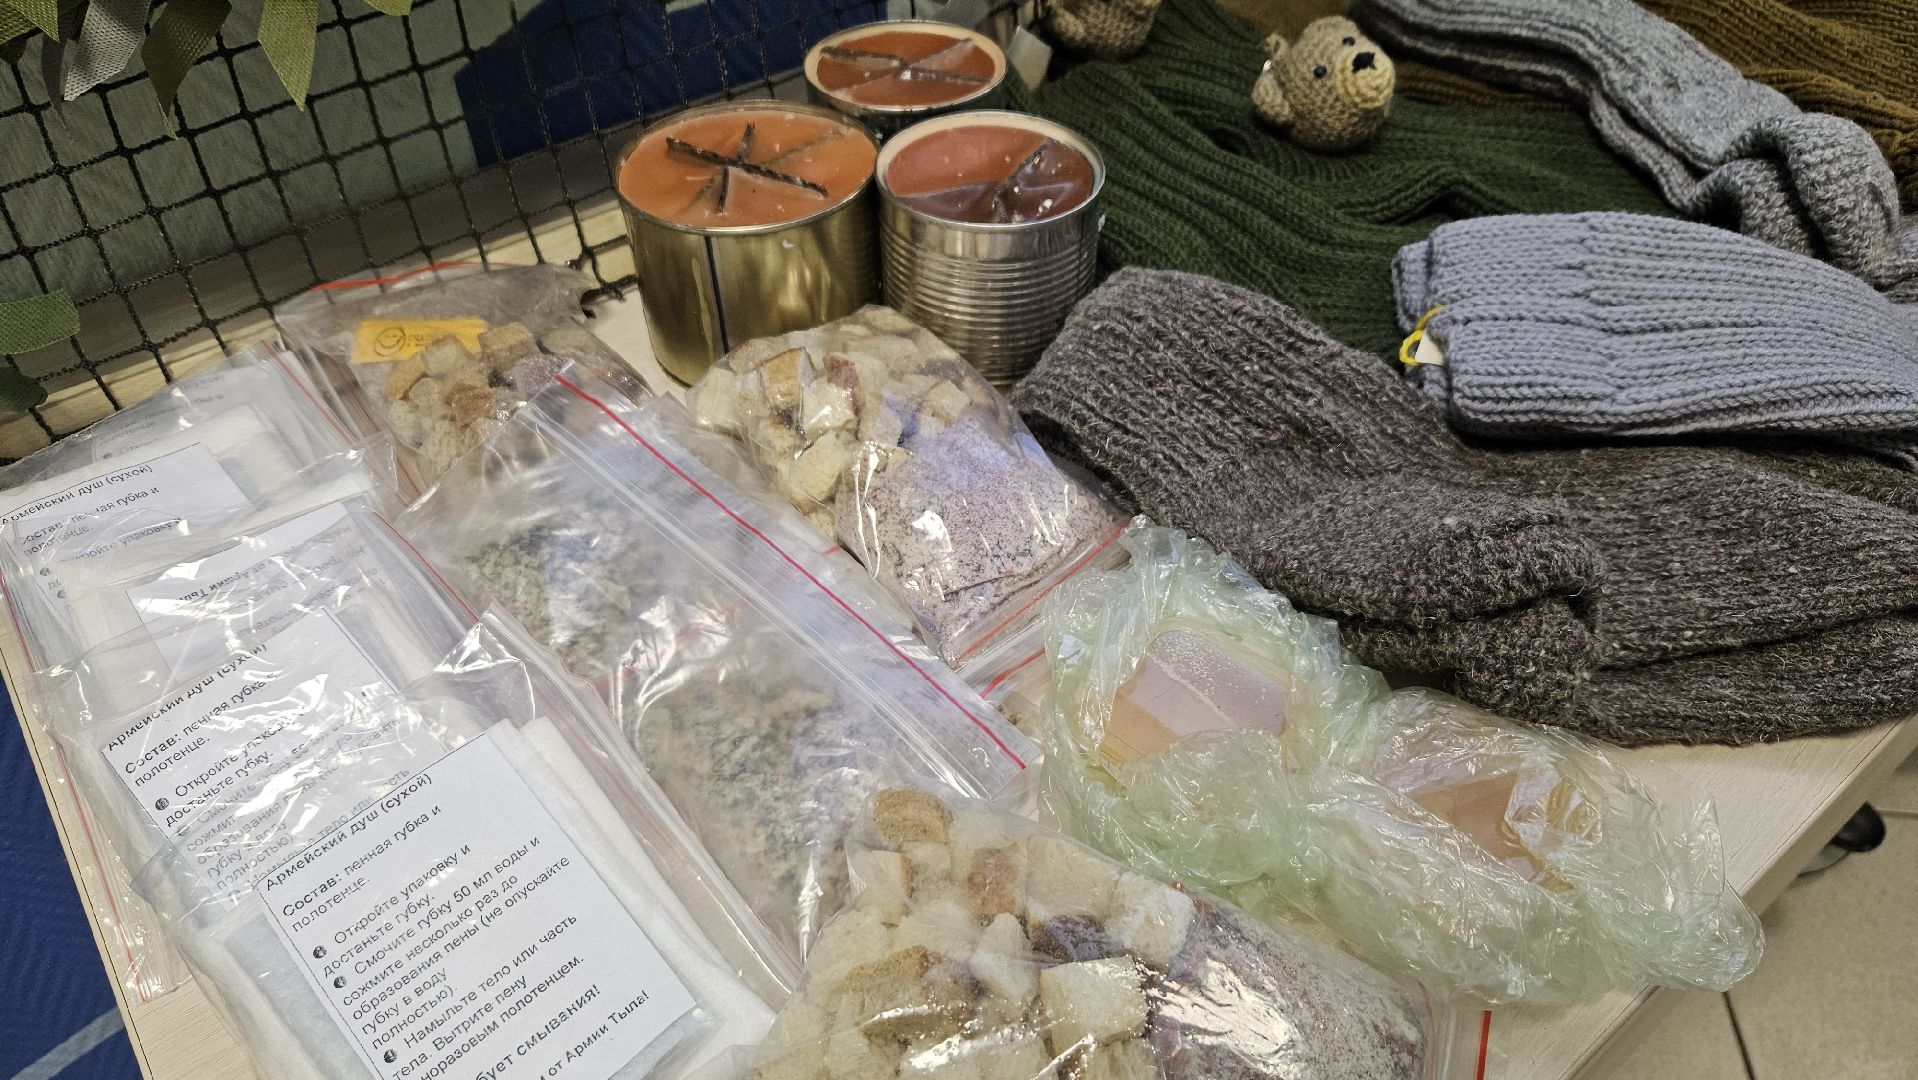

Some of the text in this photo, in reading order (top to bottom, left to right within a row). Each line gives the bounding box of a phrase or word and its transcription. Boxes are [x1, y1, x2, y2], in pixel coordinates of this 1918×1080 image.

[77, 480, 104, 496] душ
[104, 463, 153, 484] (сухой)
[115, 491, 149, 505] губка
[124, 681, 267, 773] Состав: пенная губка
[186, 676, 215, 698] душ
[133, 737, 210, 787] полотенце.
[165, 776, 234, 827] достаньте
[233, 751, 274, 777] губку.
[174, 755, 239, 796] Откройте
[185, 811, 240, 854] сожмит
[205, 849, 243, 877] губку
[266, 773, 432, 891] Армейский душ (сухой)
[281, 805, 442, 915] Состав: пенная губка и
[291, 877, 370, 932] полотенце.
[322, 893, 435, 978] достаньте губку.
[333, 844, 471, 943] Откройте упаковку и
[353, 837, 540, 973] Смочите губку 50 мл воды и
[342, 875, 518, 1005] сожмите несколько раз до
[351, 857, 570, 1019] образования пены (не опускайте
[361, 967, 447, 1034] губку в воду
[371, 985, 454, 1049] полностью).
[402, 916, 577, 1048] Намыльте тело или часть
[419, 956, 584, 1080] норазовым полотенцем.
[391, 975, 527, 1080] тела. Вытрите пену
[474, 984, 601, 1080] бует смывания!
[547, 990, 650, 1076] от Армии Тыла!
